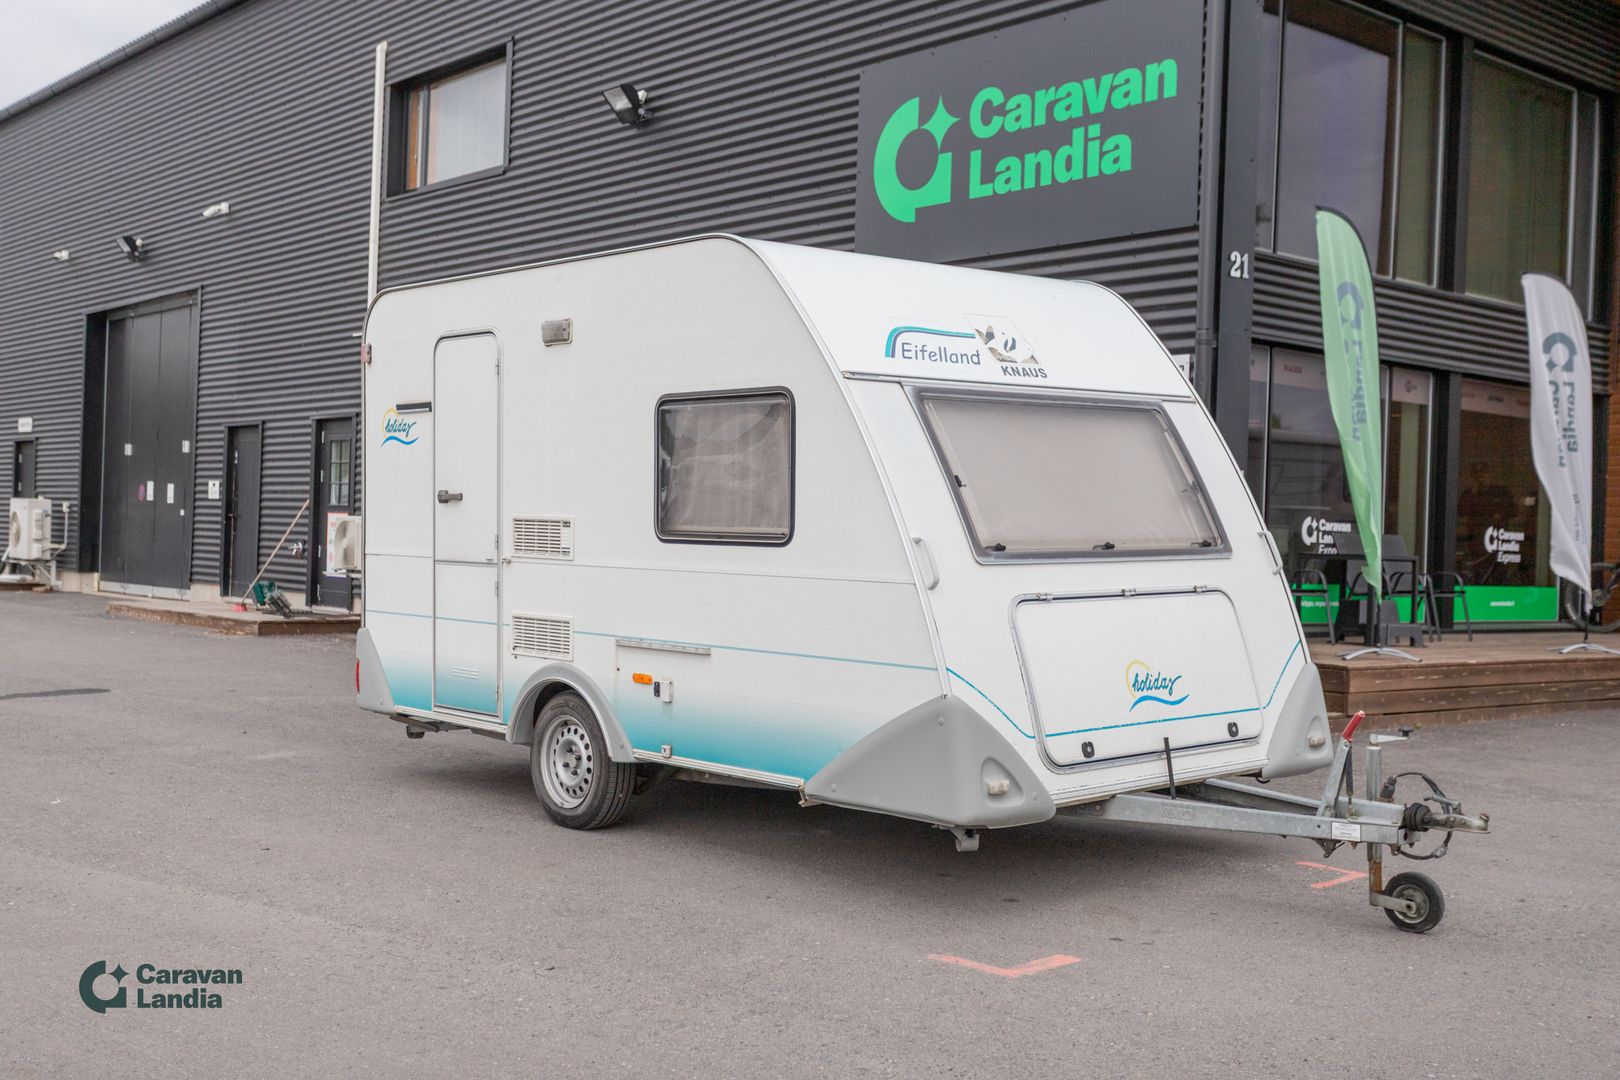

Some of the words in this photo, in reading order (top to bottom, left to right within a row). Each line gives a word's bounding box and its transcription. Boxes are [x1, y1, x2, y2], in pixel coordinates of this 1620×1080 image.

[968, 57, 1178, 139] Caravan
[968, 123, 1133, 200] Landia
[1230, 250, 1250, 279] 21
[901, 342, 981, 366] Eifelland
[1000, 365, 1048, 379] KNAUS
[385, 418, 417, 438] holiday
[1318, 518, 1352, 533] Caravan
[1132, 671, 1183, 696] holiday
